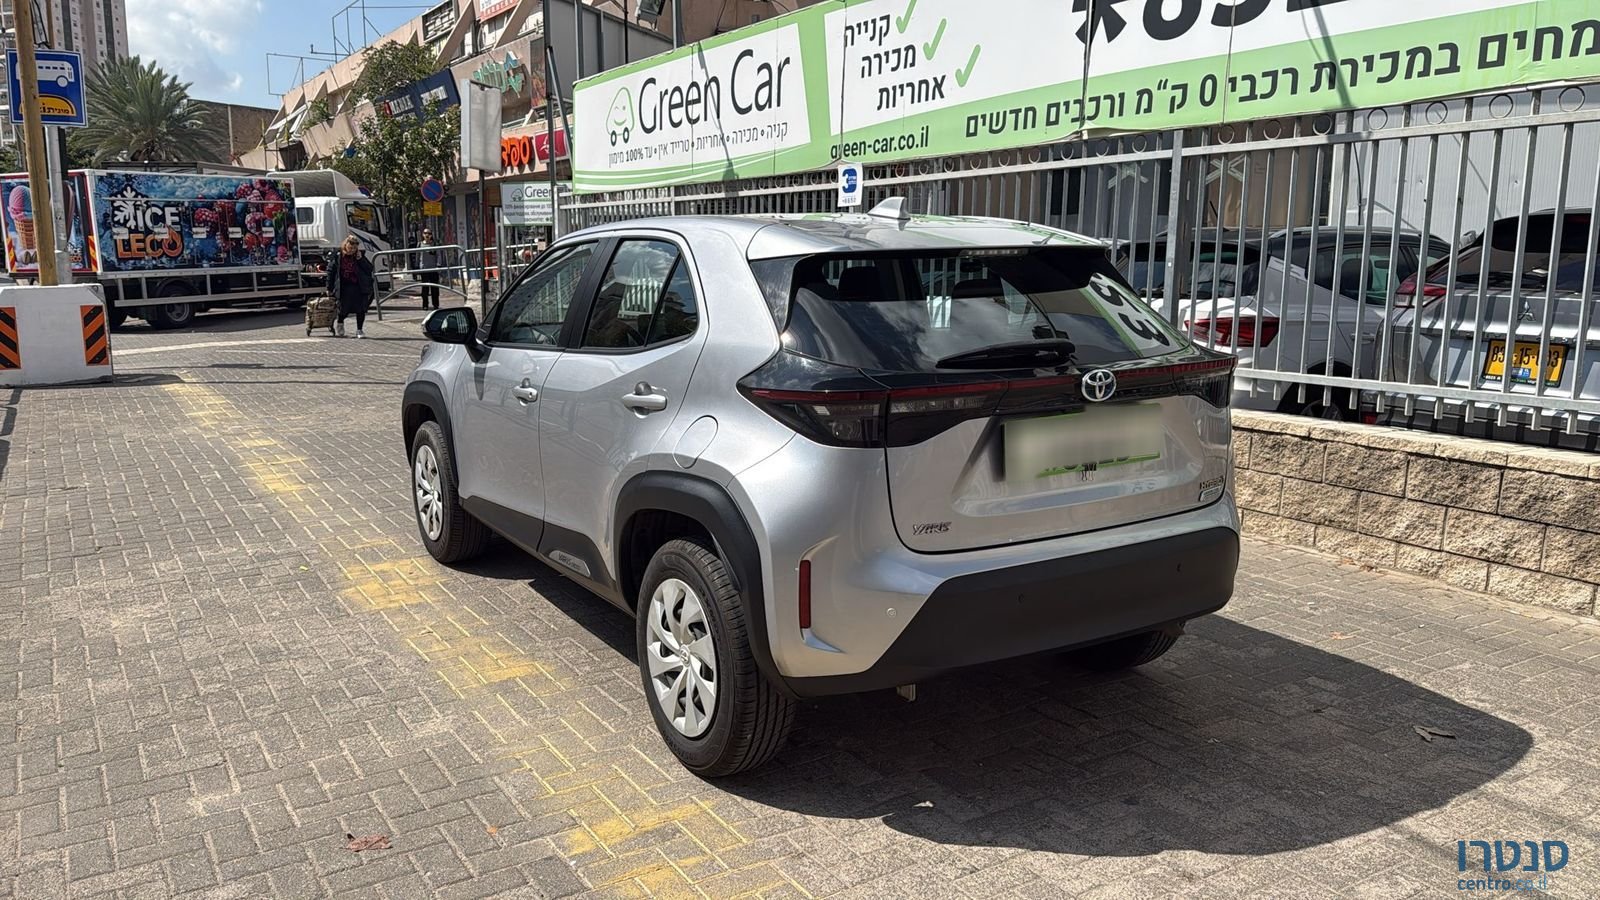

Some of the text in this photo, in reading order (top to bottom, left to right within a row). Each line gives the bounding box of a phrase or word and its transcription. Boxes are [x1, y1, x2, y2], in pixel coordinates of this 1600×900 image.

[845, 14, 891, 47] קנייה
[861, 44, 916, 78] מכירה
[1310, 42, 1461, 93] במכירת
[638, 49, 790, 134] Green Car
[877, 75, 946, 110] אחריות
[1200, 74, 1218, 107] 0
[1228, 67, 1299, 103] רכבי
[966, 105, 1037, 138] חדשים
[1046, 92, 1125, 127] ורכבים
[695, 133, 726, 150] אחריות
[732, 126, 759, 145] מכירה
[766, 122, 788, 142] קניה
[626, 148, 644, 162] 100%
